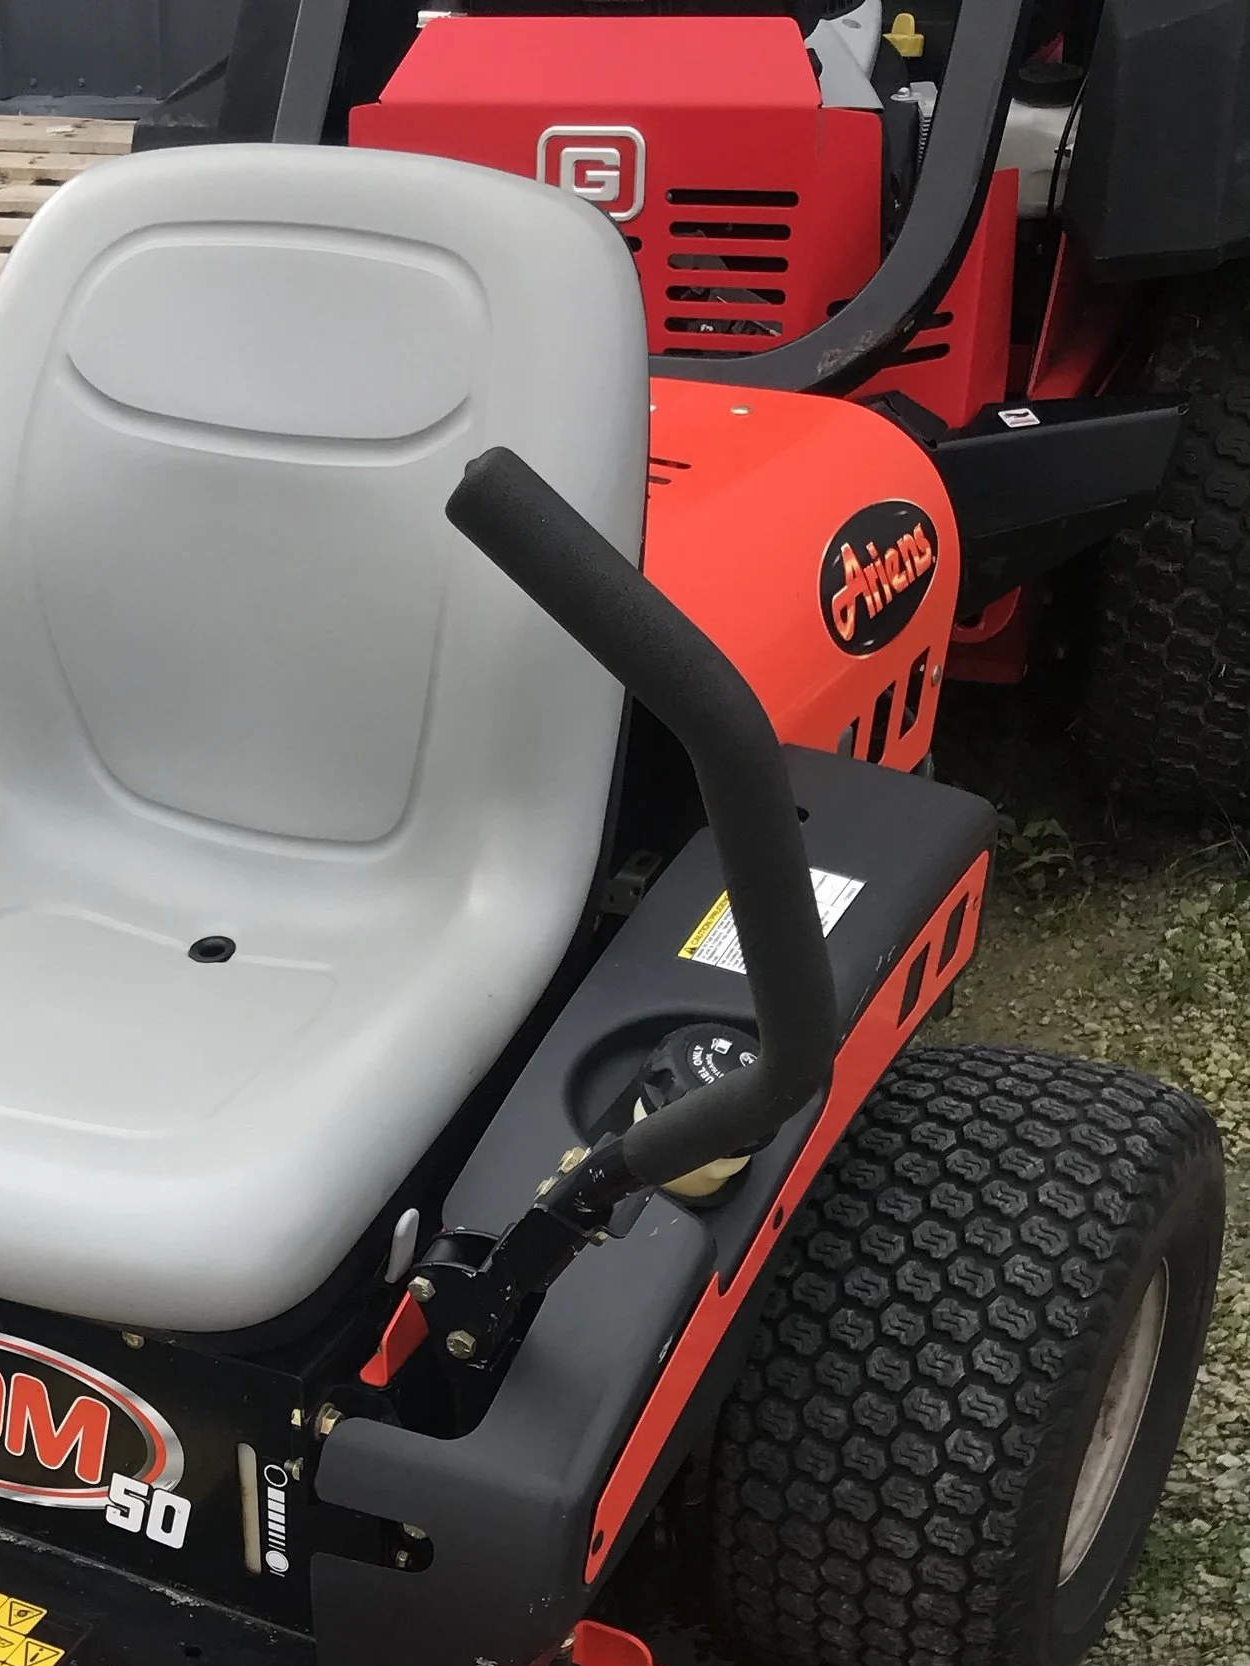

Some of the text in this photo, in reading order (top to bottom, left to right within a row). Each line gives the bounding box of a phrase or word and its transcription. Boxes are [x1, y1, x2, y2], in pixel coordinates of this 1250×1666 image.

[561, 147, 620, 201] G
[831, 522, 932, 641] Ariens
[692, 1045, 715, 1084] UEL ONLY
[105, 1473, 192, 1549] 50
